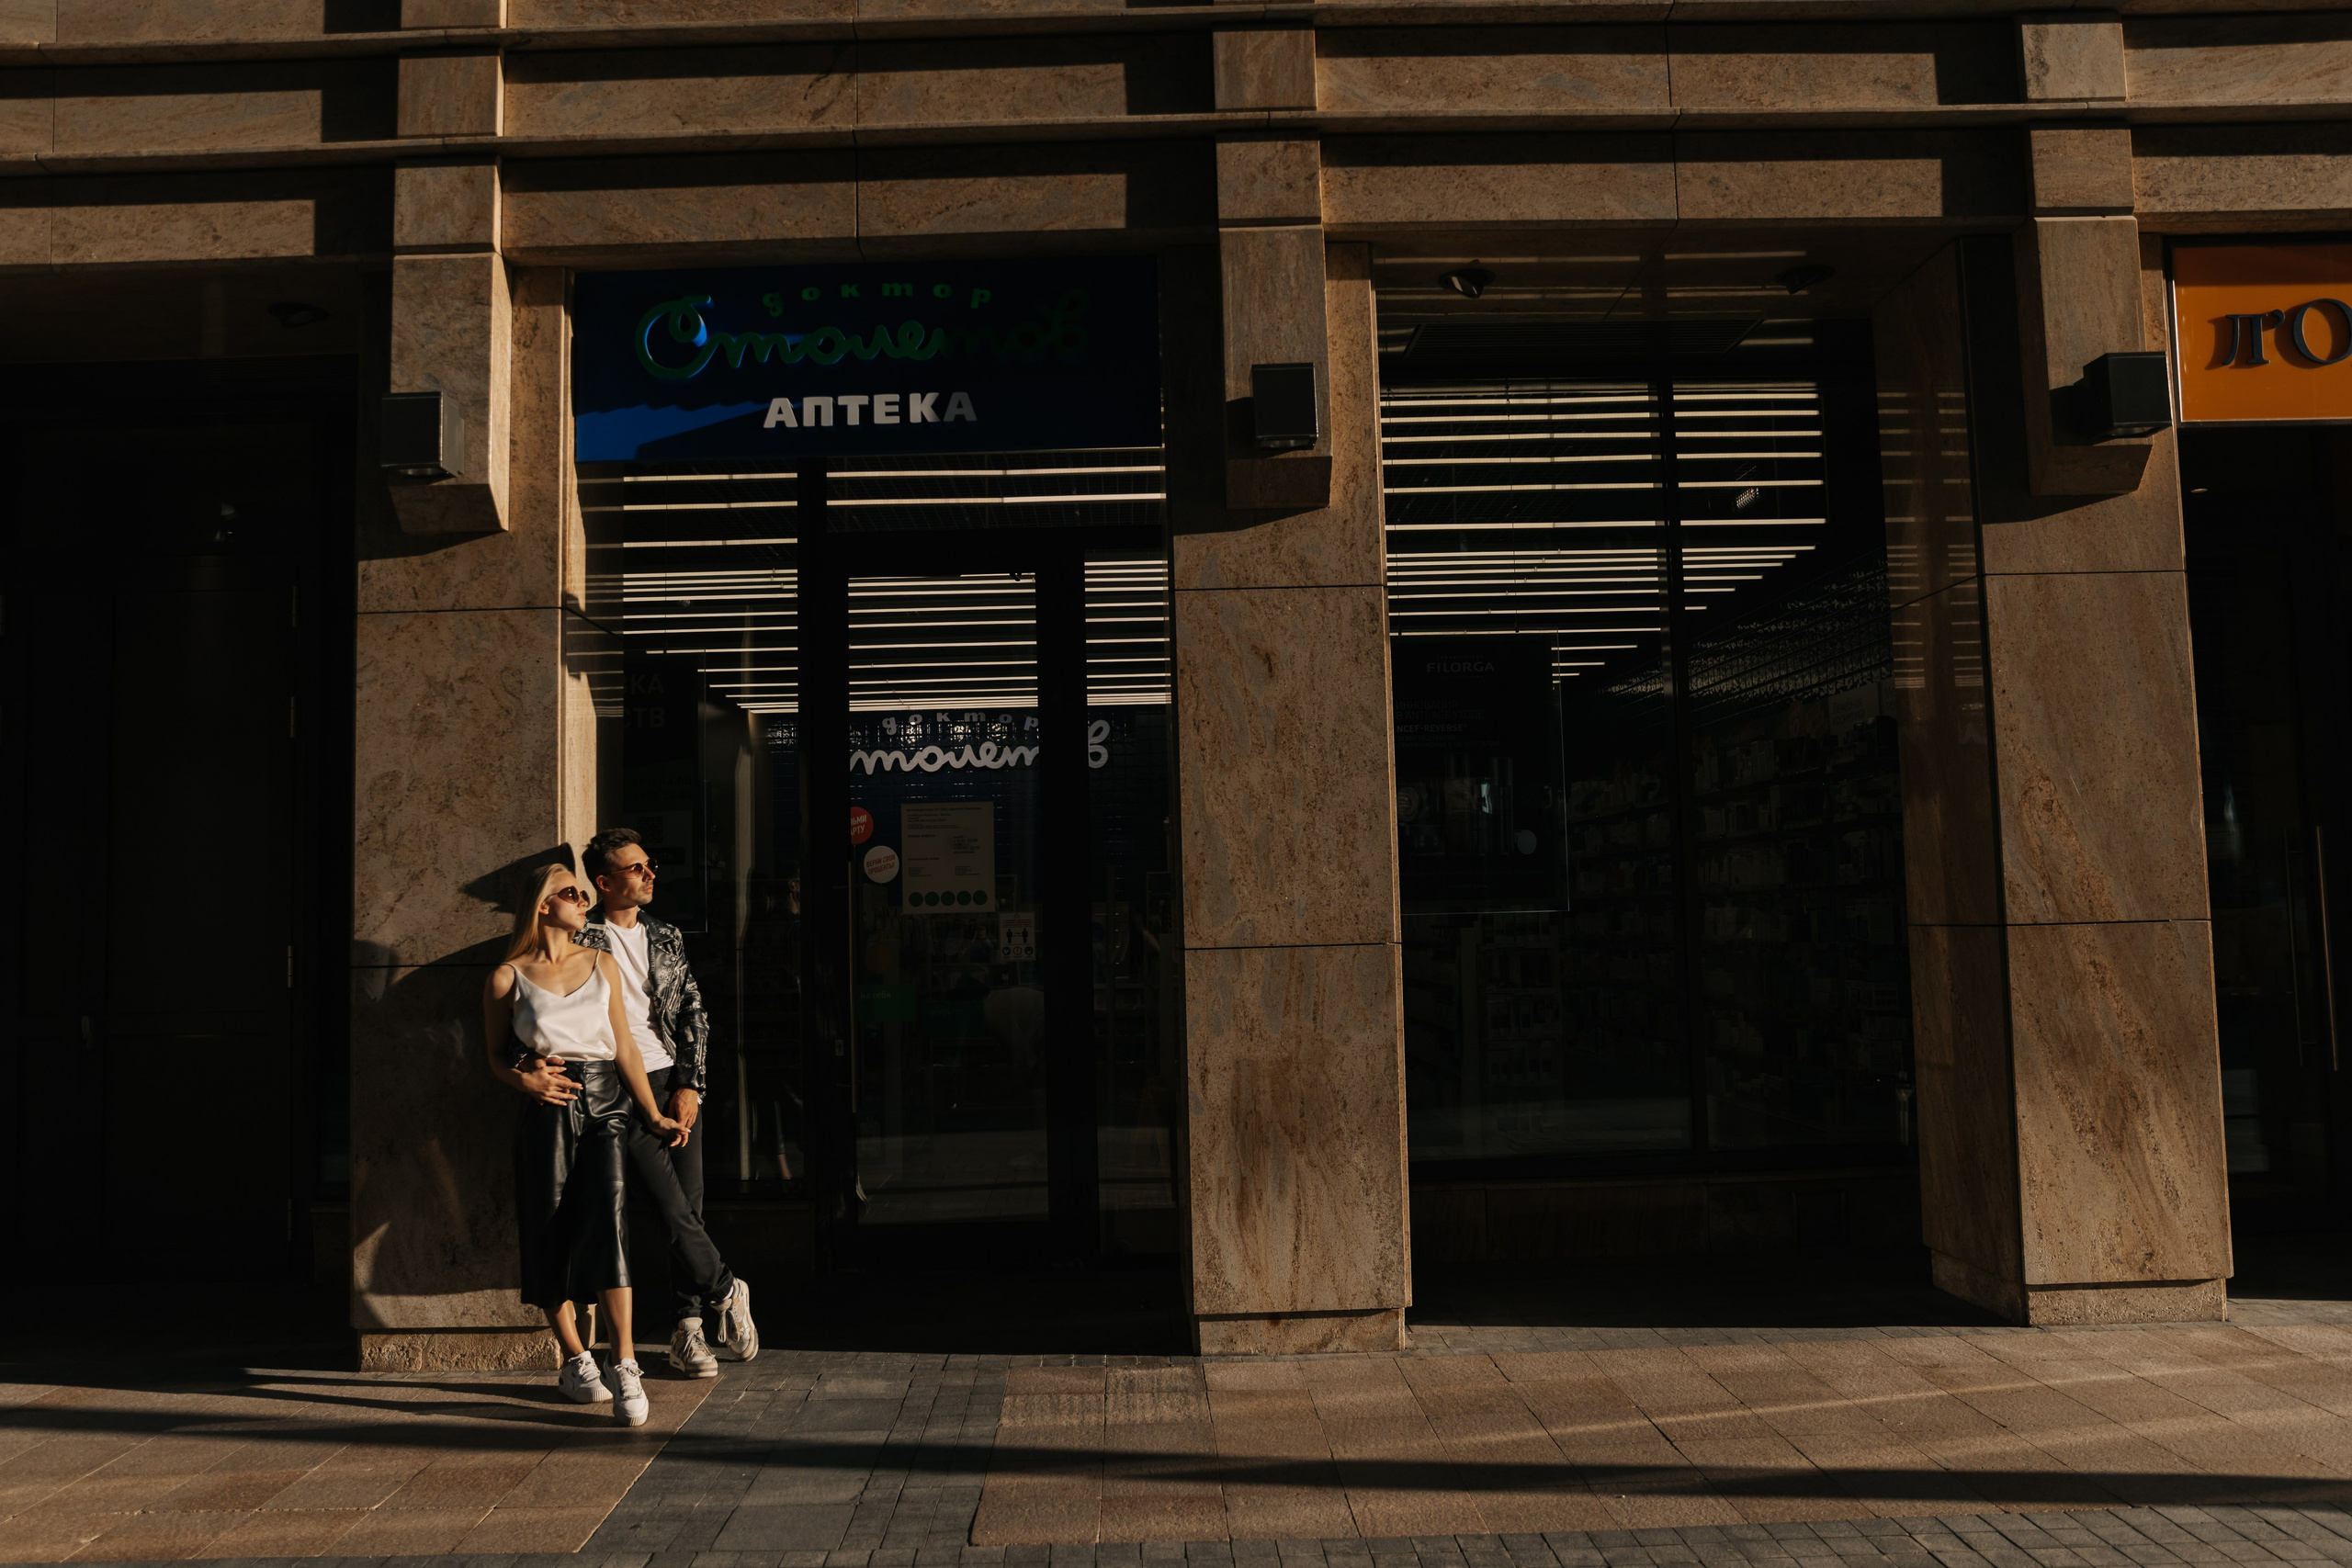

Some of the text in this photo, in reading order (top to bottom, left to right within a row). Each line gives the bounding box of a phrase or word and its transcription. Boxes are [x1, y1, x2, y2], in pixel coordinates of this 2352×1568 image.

[763, 391, 978, 429] АПТЕКА
[1426, 661, 1496, 673] FILORGA
[881, 712, 1039, 736] доктор
[872, 990, 891, 999] себя
